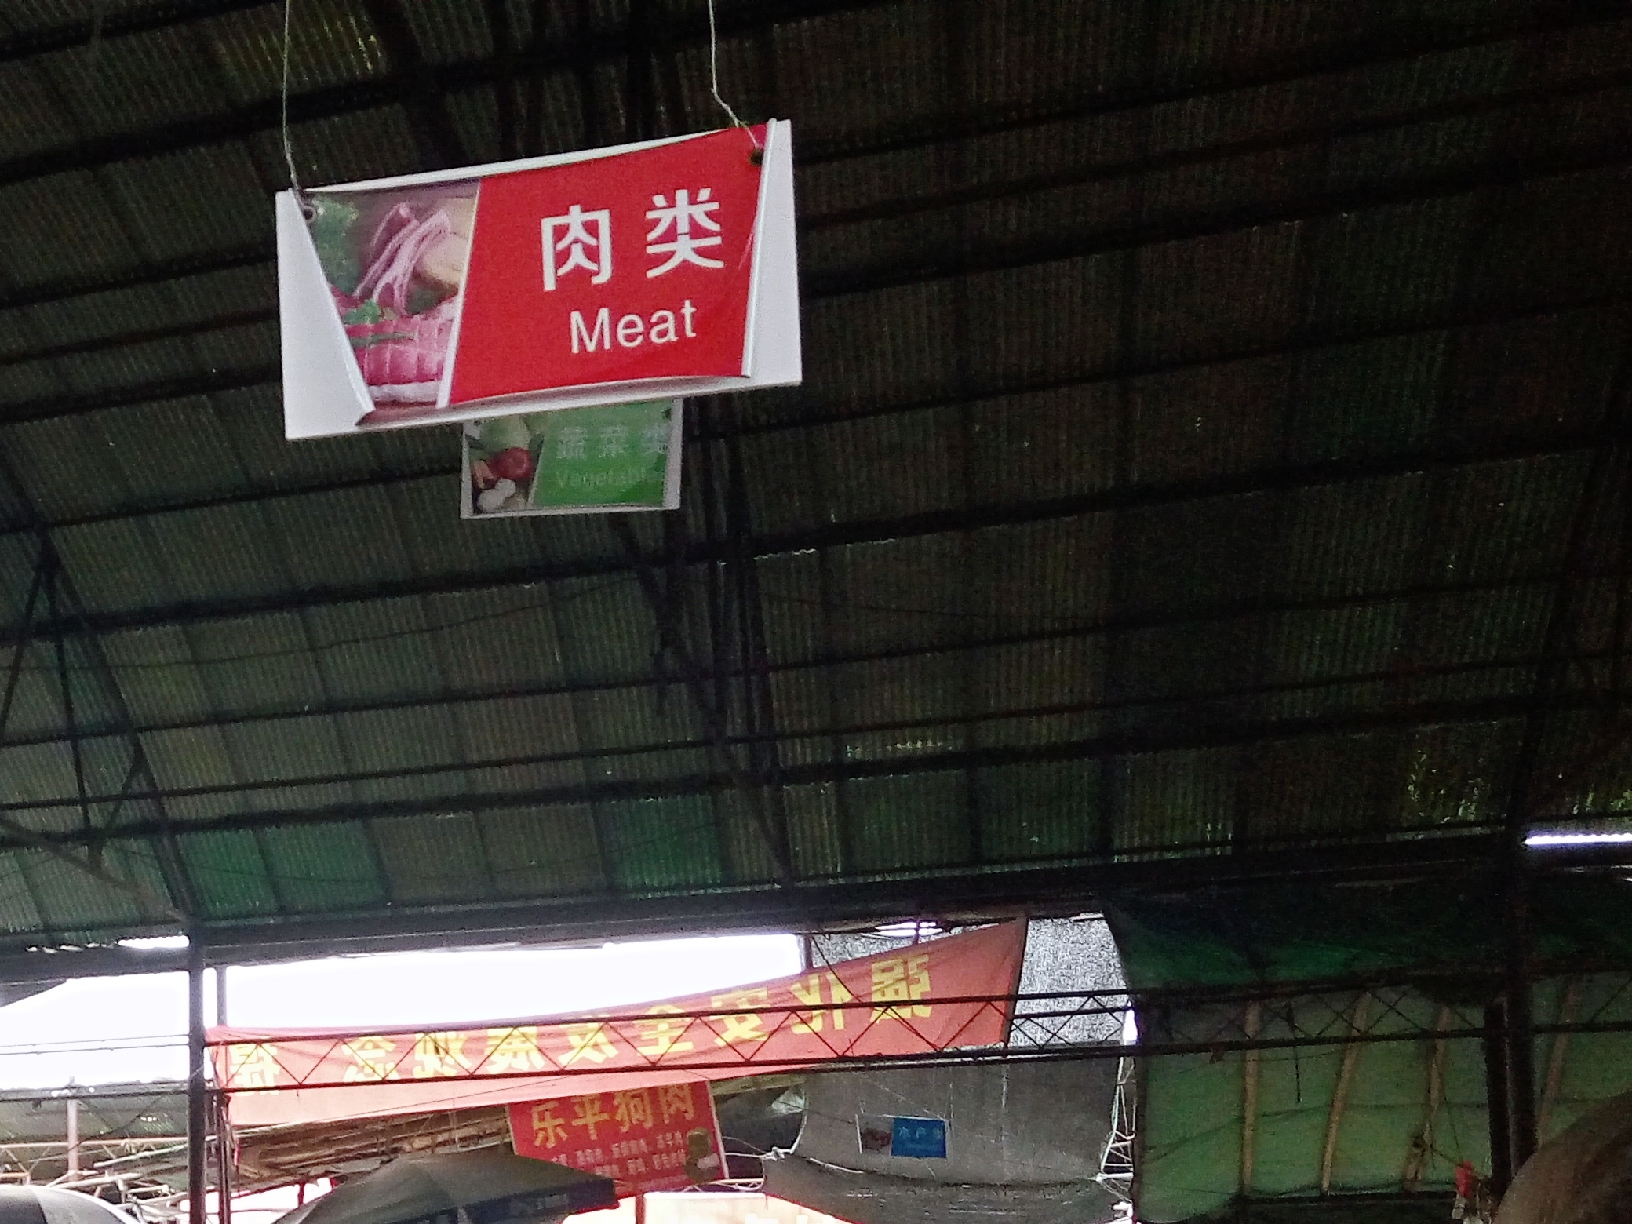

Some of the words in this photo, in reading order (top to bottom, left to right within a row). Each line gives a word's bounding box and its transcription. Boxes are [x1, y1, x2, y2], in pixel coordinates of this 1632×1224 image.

[540, 188, 725, 291] 肉类
[568, 299, 698, 354] Meat
[531, 1083, 695, 1148] 乐平狗肉
